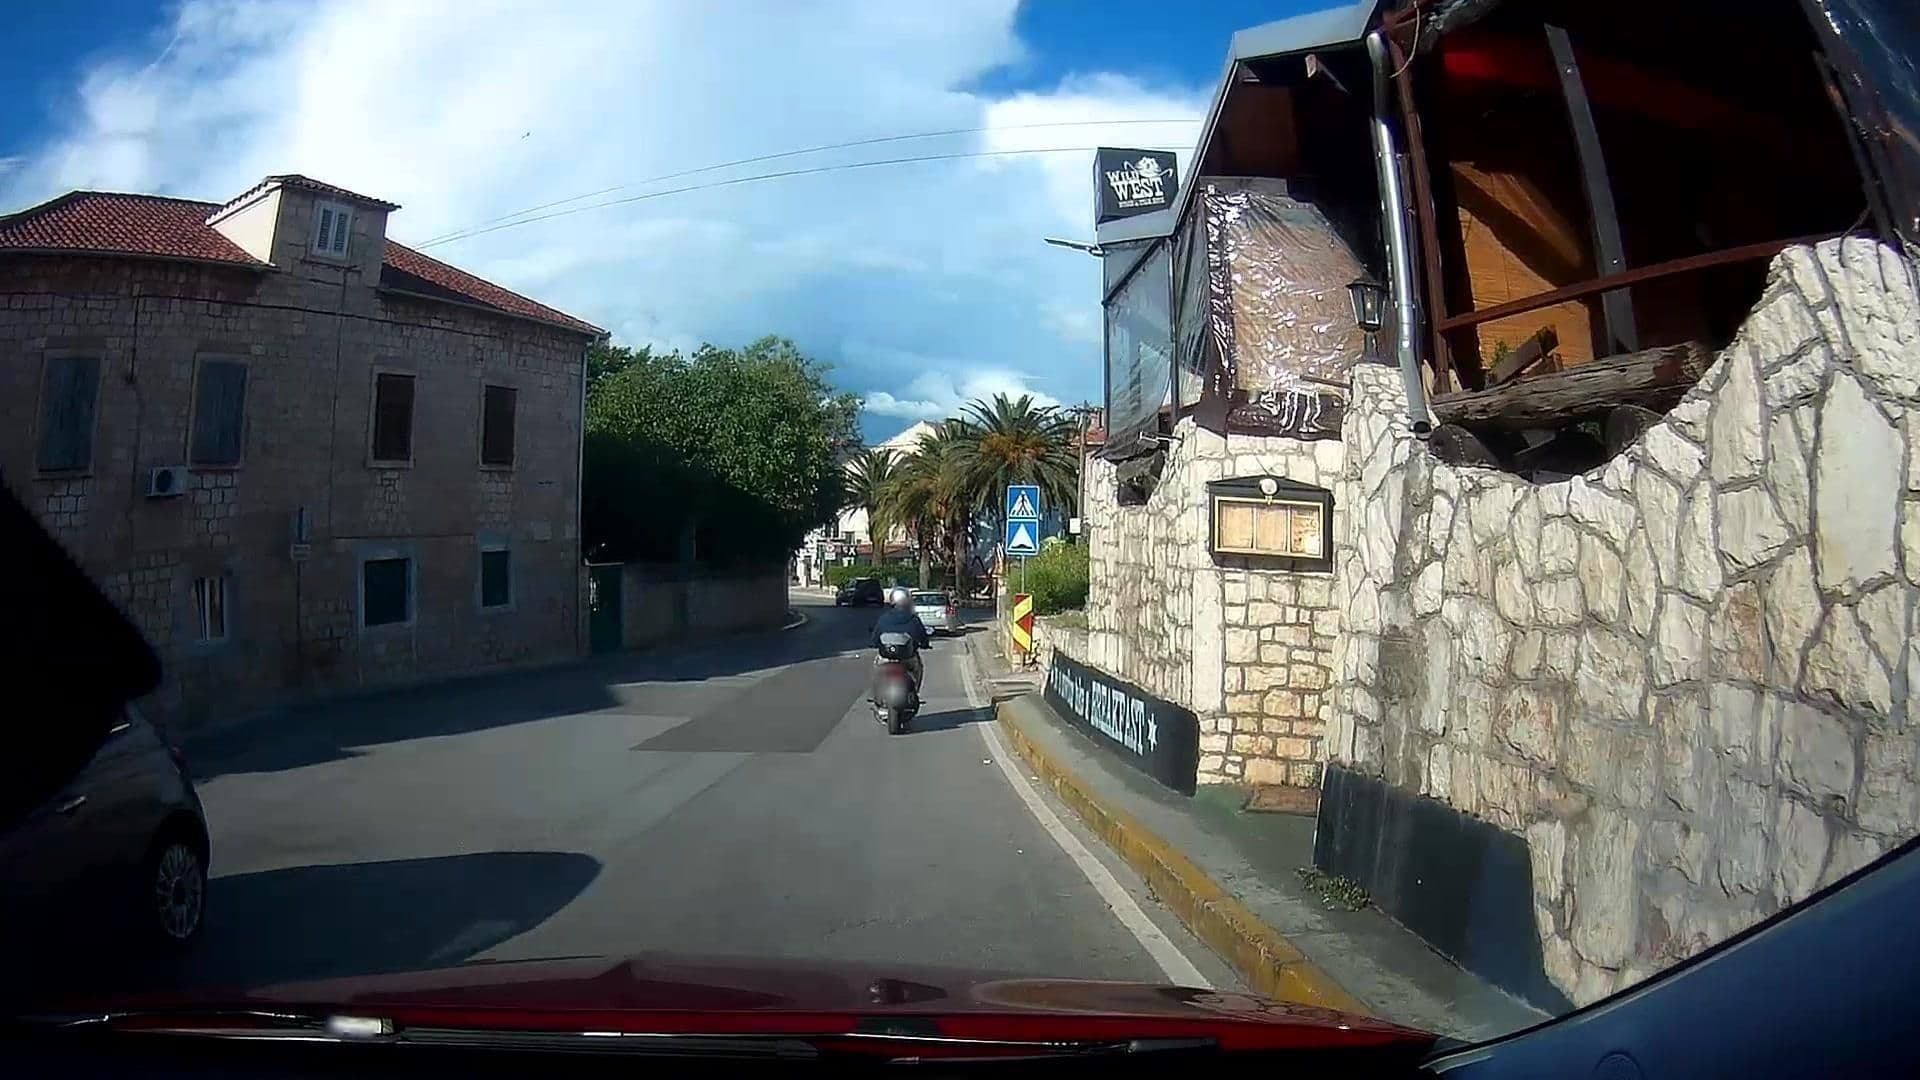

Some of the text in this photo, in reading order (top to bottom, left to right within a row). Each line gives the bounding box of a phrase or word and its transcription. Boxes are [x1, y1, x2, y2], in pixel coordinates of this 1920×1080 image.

[1105, 170, 1139, 182] WILD
[1110, 177, 1164, 201] WEST
[1090, 680, 1145, 756] BREAKFAST
